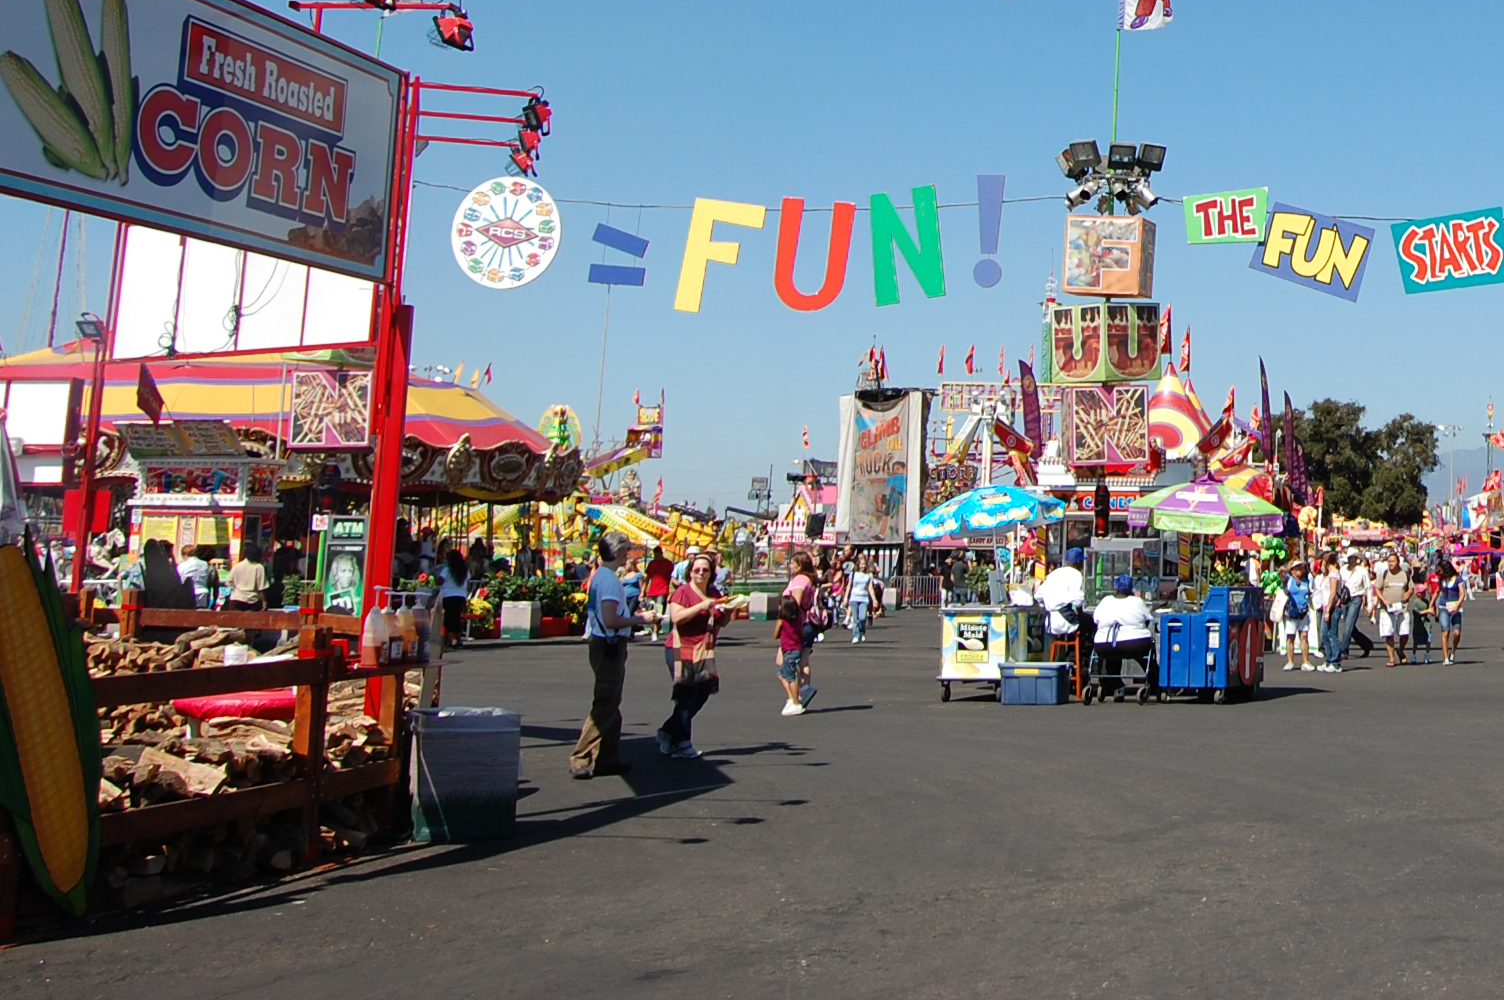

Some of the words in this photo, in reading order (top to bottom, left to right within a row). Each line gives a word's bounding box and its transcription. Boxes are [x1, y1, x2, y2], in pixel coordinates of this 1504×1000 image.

[198, 34, 256, 92] Fresh
[263, 55, 336, 122] Roasted
[136, 84, 357, 224] CORN
[488, 226, 527, 239] RCS
[1194, 193, 1259, 239] THE
[1262, 211, 1371, 290] FUN
[1399, 215, 1504, 284] STARTS
[147, 467, 239, 494] TICKETS
[333, 521, 364, 534] ATM
